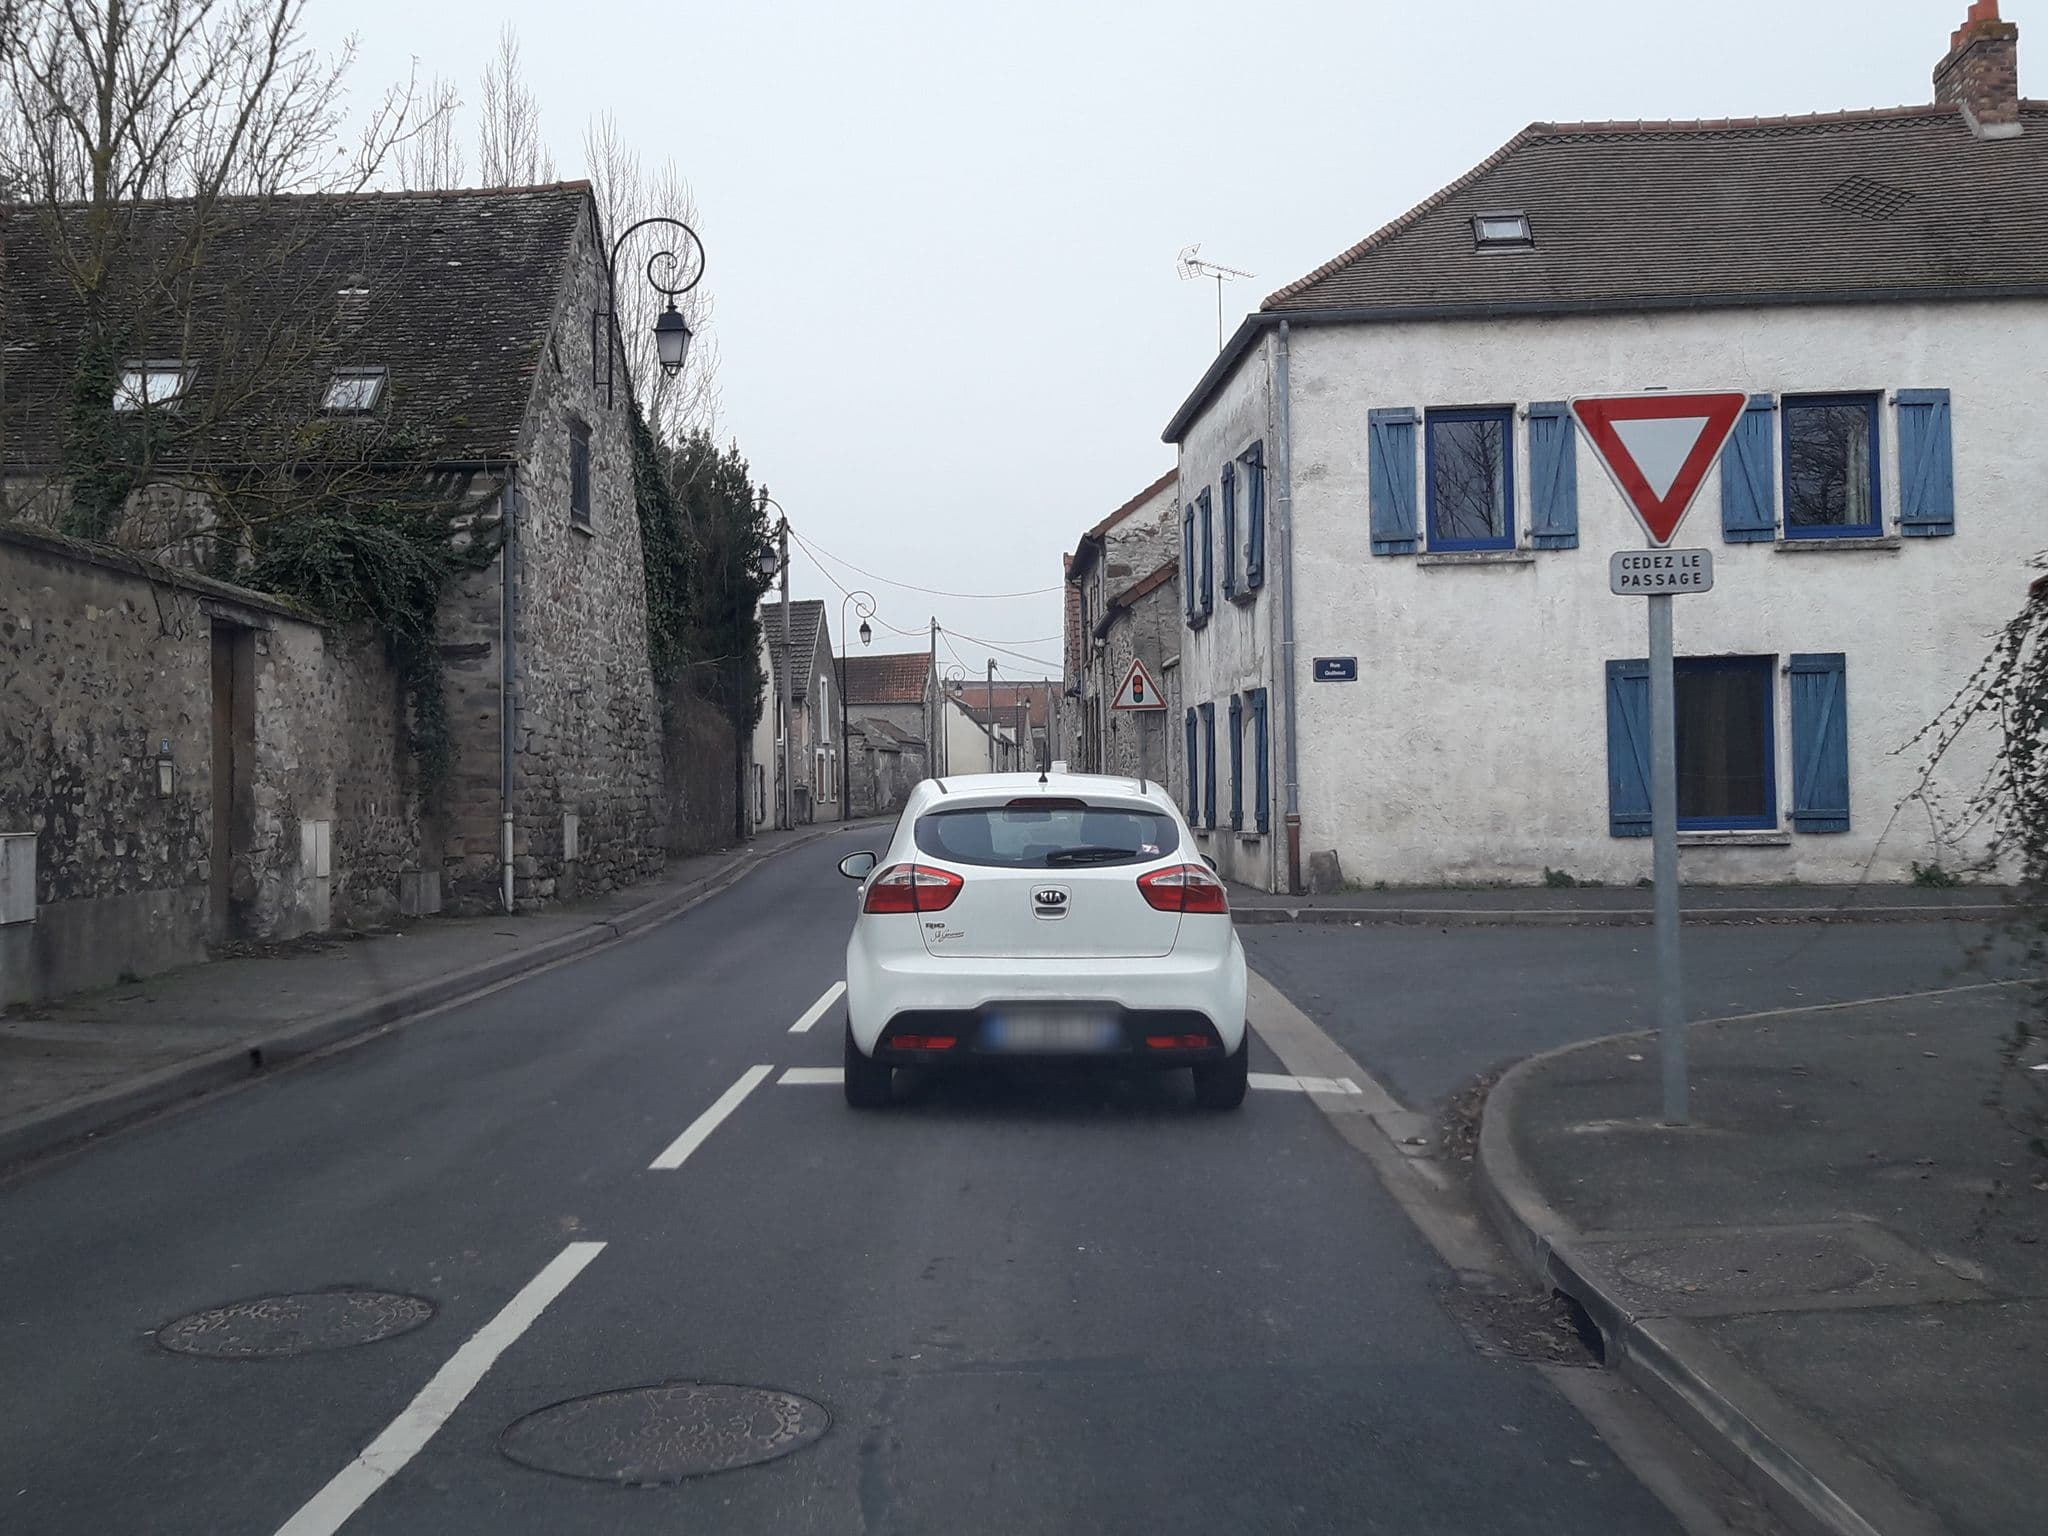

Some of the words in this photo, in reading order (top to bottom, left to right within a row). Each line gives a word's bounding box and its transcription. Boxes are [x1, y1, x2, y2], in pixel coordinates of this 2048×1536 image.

[1622, 556, 1673, 570] CEDEZ
[1682, 555, 1700, 568] LE
[1621, 572, 1702, 587] PASSAGE
[1040, 892, 1062, 902] KIA
